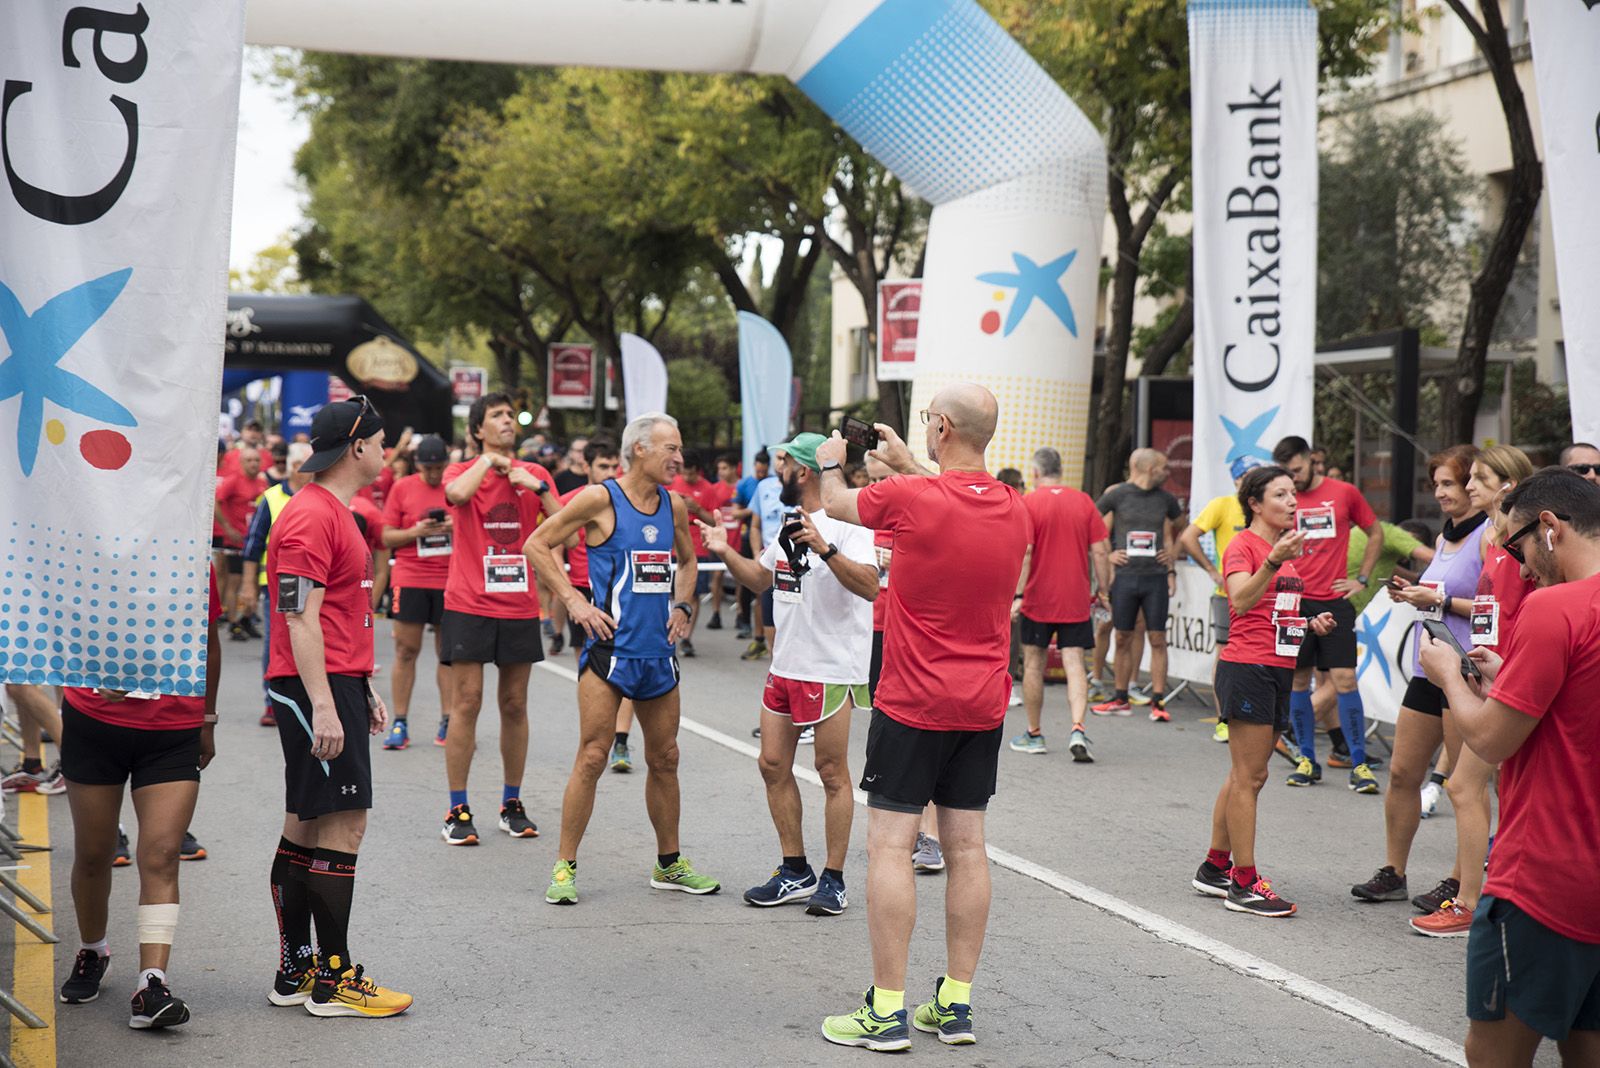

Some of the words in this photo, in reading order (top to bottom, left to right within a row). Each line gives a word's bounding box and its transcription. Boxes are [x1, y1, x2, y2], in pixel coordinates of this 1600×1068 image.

[2, 2, 150, 225] Ca
[1223, 79, 1283, 393] CaixaBank
[494, 566, 519, 576] MARC
[641, 564, 667, 574] MIGUEL
